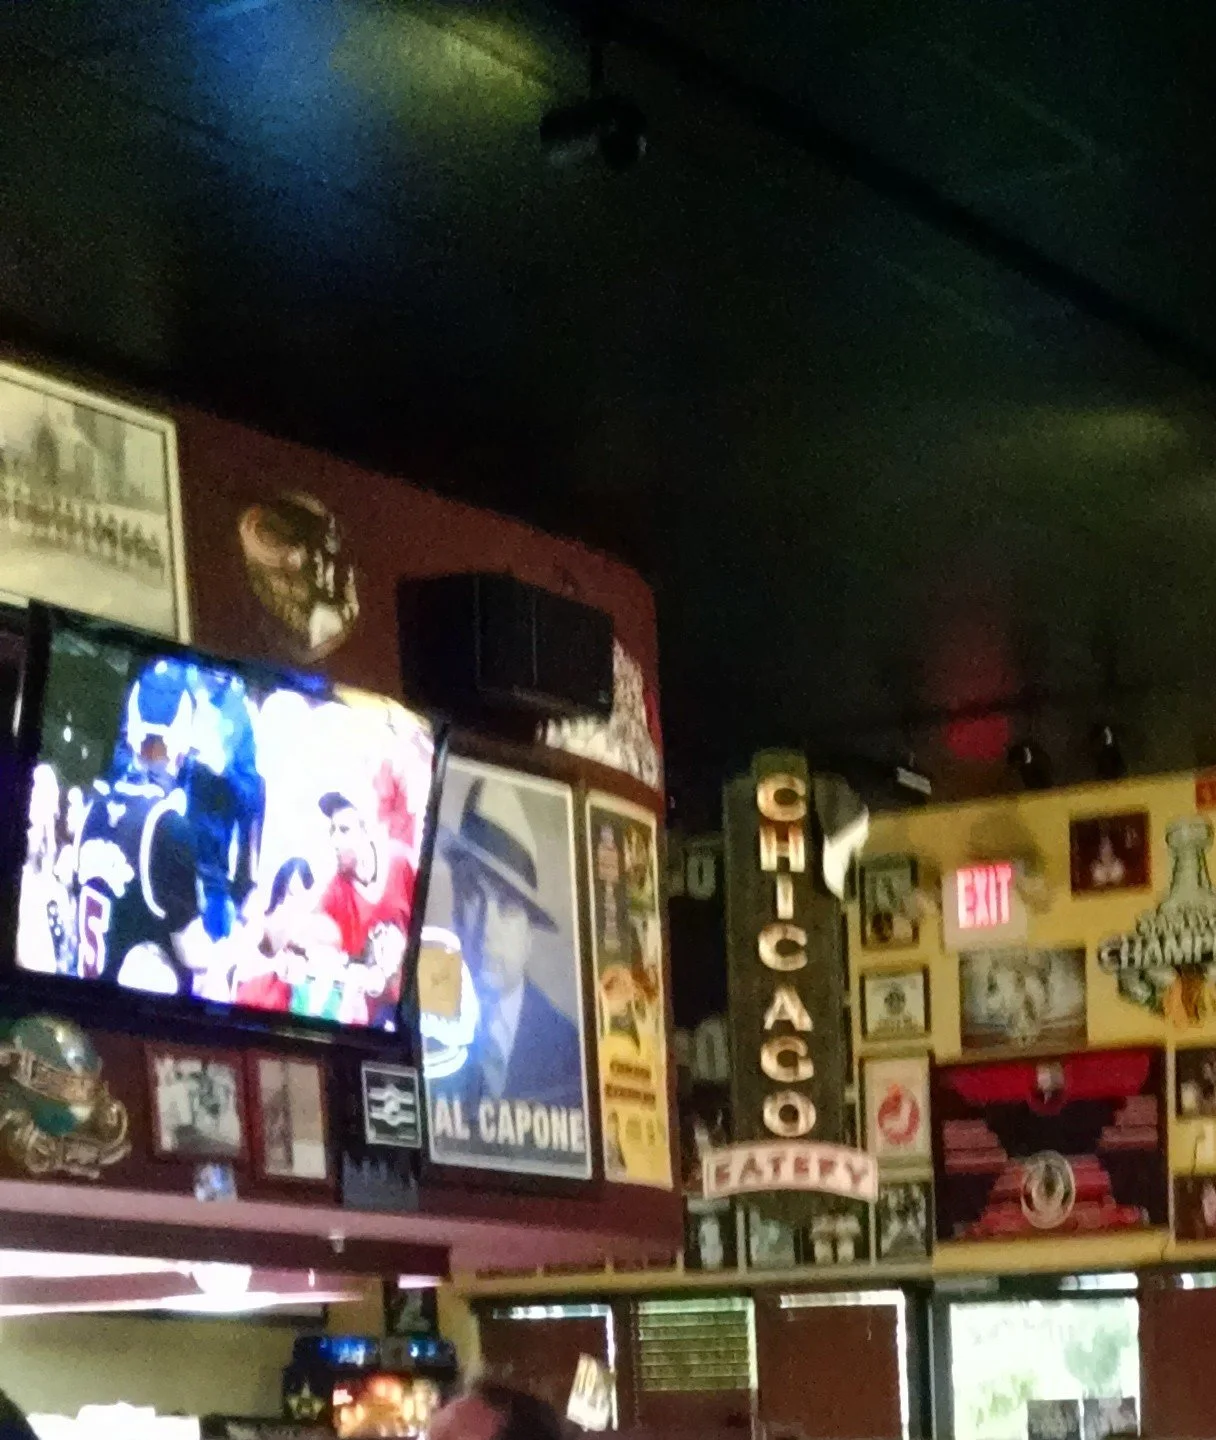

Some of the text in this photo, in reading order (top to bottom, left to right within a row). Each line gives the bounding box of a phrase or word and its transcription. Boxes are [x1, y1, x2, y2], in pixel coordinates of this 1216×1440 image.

[956, 864, 1012, 929] EXIT
[756, 773, 817, 1138] CHICAGO
[434, 1093, 586, 1153] AL CAPONE
